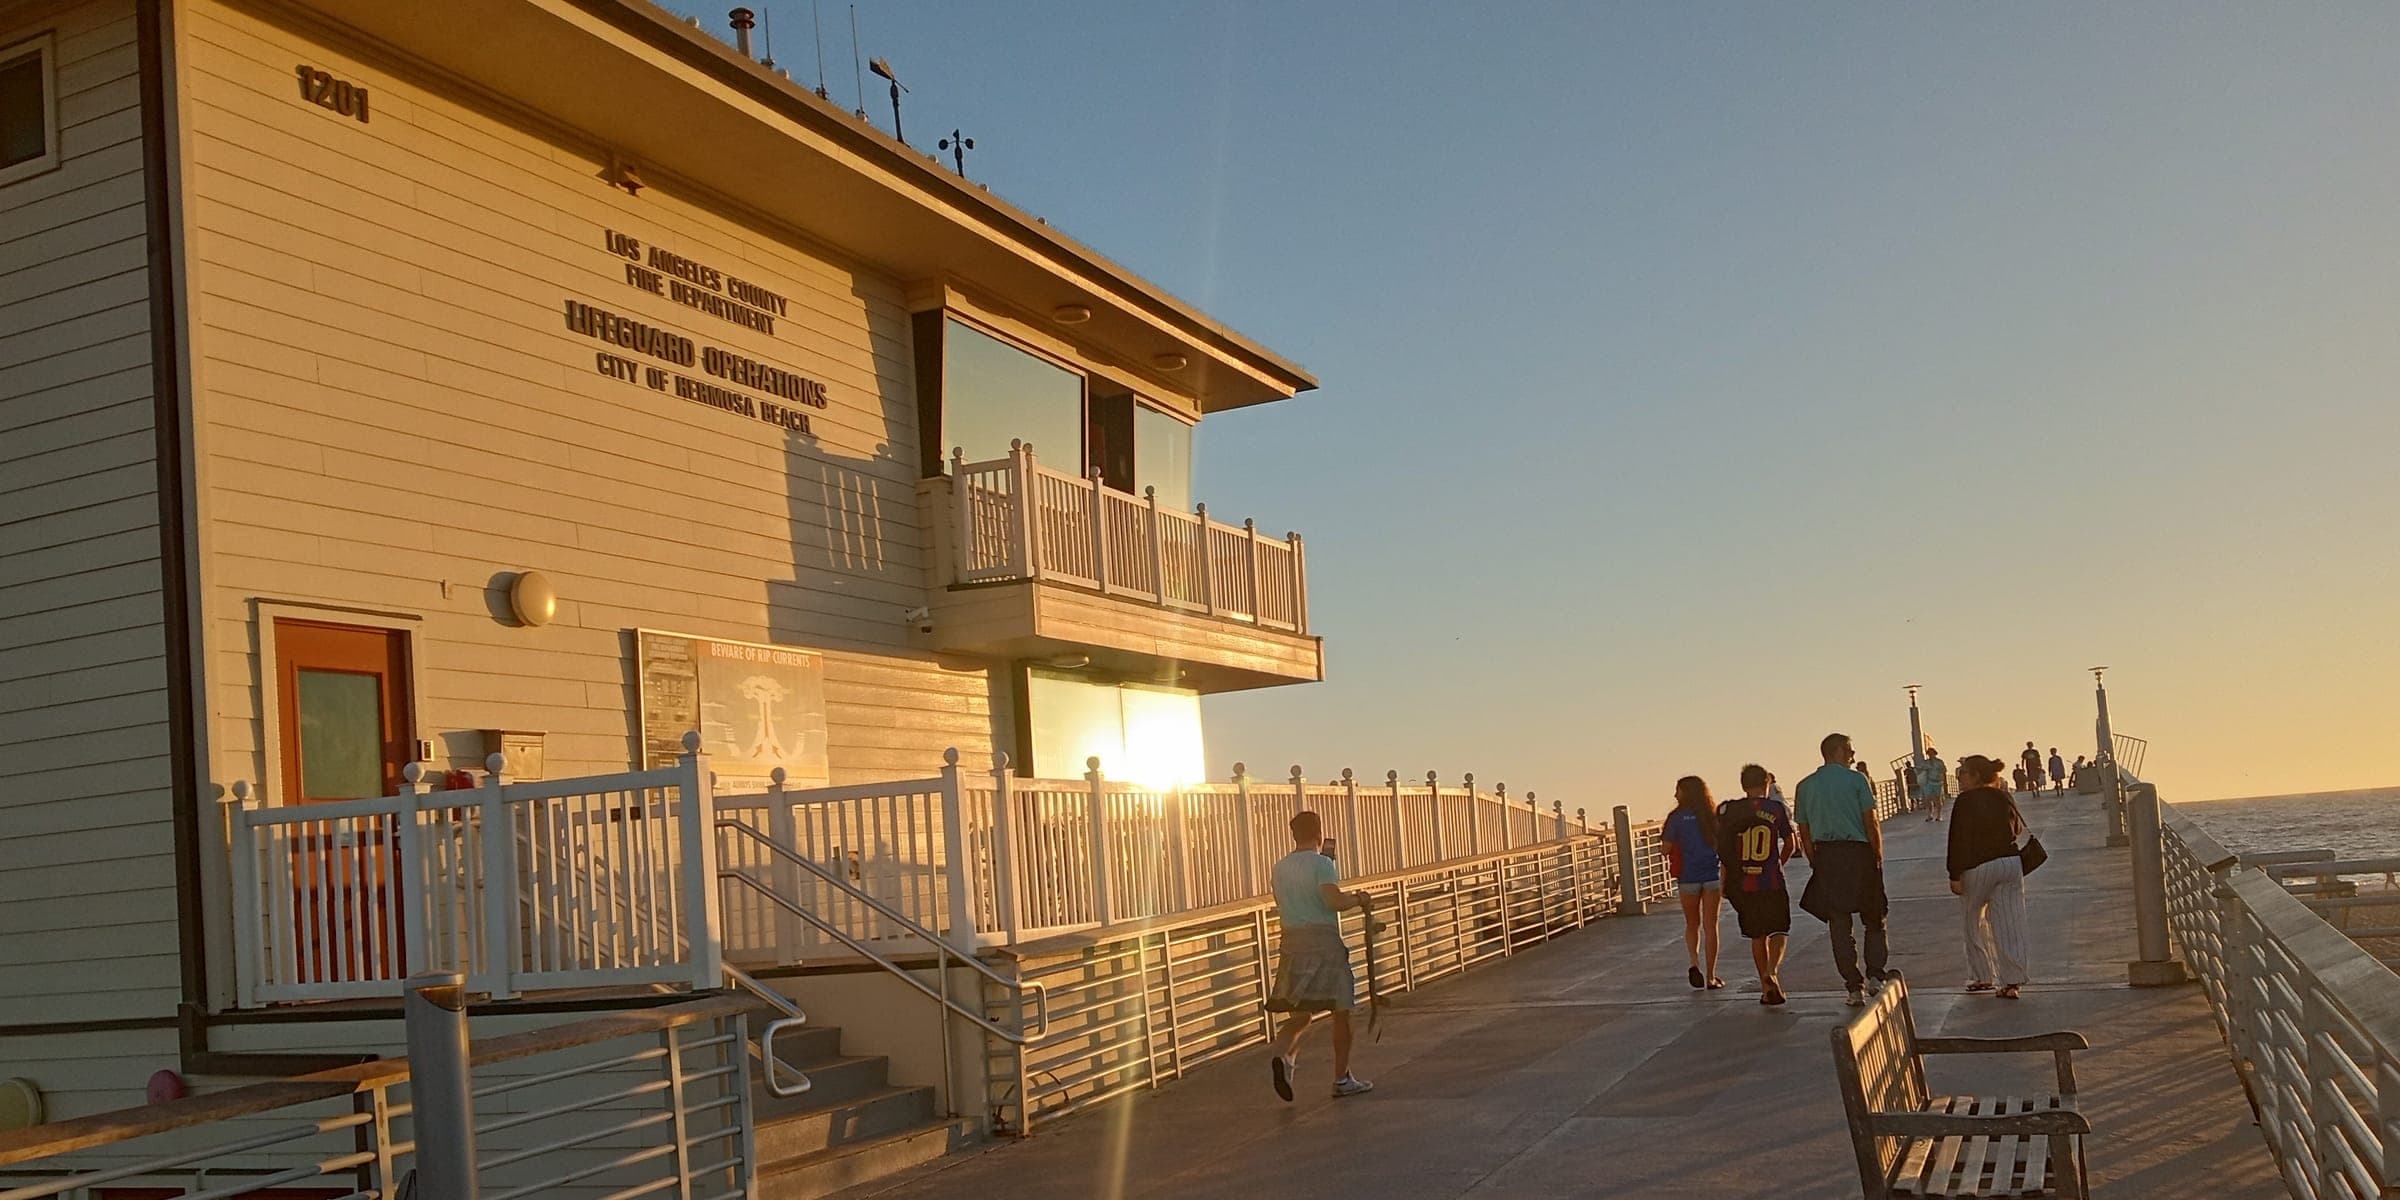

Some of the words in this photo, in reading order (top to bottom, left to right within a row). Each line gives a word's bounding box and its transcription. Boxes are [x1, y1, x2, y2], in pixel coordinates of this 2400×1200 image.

[295, 64, 370, 124] 1201
[605, 229, 641, 261] LOS
[647, 246, 722, 292] ANGELES
[727, 277, 788, 317] COUNTY
[625, 263, 664, 296] FIRE
[670, 279, 776, 336] DEPARTMENT
[564, 300, 696, 368] LIFEGUARD
[702, 346, 828, 410] OPERATIONS
[596, 352, 638, 384] CITY
[646, 367, 669, 391] OF
[675, 375, 756, 419] HERMOSA
[760, 400, 811, 434] BEACH
[711, 642, 744, 660] BEWARE
[745, 648, 756, 661] OF
[757, 649, 771, 663] RIP
[772, 651, 810, 668] CURRENTS
[1738, 825, 1771, 861] 10
